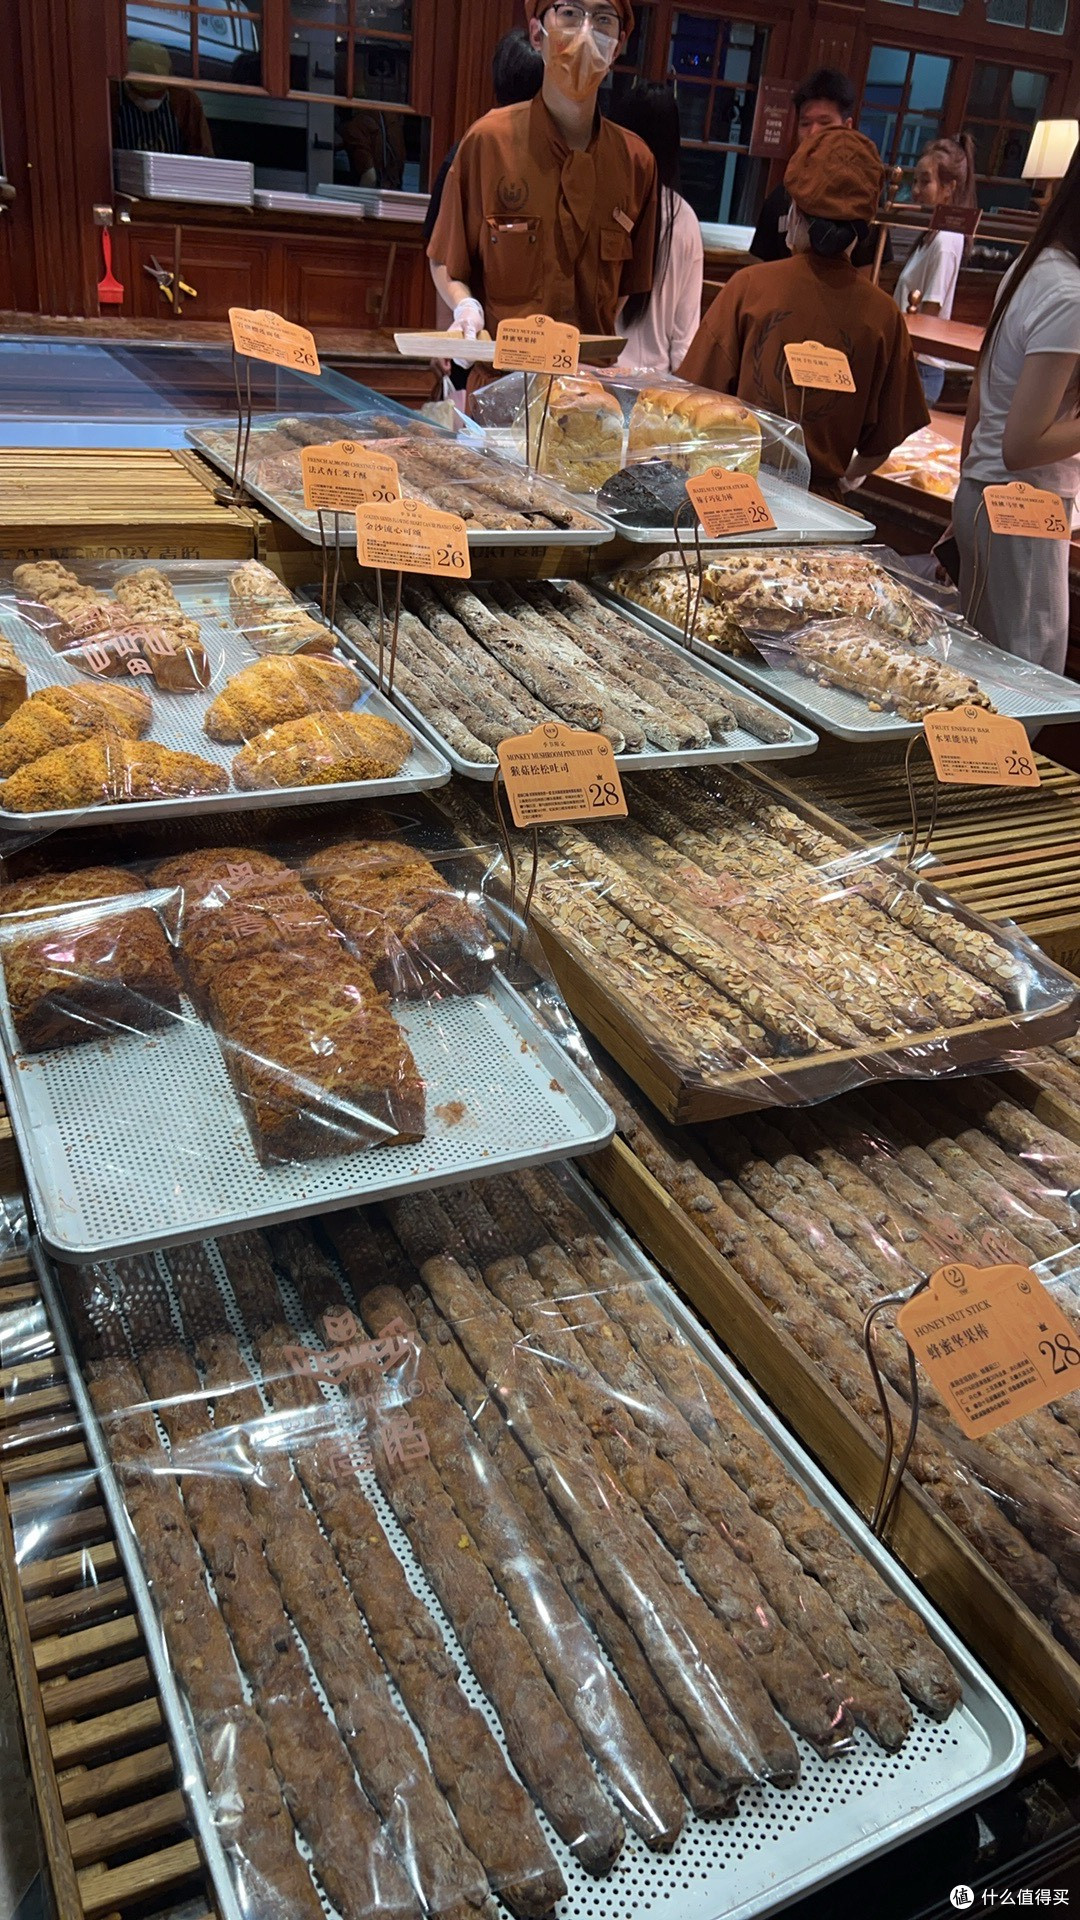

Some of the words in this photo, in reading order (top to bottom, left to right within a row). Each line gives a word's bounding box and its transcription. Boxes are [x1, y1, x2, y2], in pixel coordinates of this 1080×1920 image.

[293, 349, 316, 367] 26
[552, 354, 572, 368] 28
[834, 372, 851, 386] 38
[748, 506, 769, 523] 28
[365, 522, 422, 538] 金沙流心可颂
[1044, 517, 1066, 533] 25
[436, 548, 465, 569] 26
[951, 725, 975, 733] ENERGY
[935, 733, 979, 745] 水果能量棒
[506, 753, 531, 761] MONKEY
[531, 751, 564, 760] MUSHROOM
[564, 749, 576, 757] PINE
[576, 748, 594, 756] TOAST
[510, 763, 569, 777] 猴菇松松吐司
[1004, 755, 1033, 776] 28
[588, 782, 620, 807] 28
[948, 1269, 962, 1284] 2
[913, 1317, 946, 1338] HONEY
[945, 1311, 967, 1325] NUT
[966, 1300, 993, 1317] STICK
[926, 1322, 990, 1360] 蜂蜜坚果棒
[1038, 1333, 1080, 1375] 28
